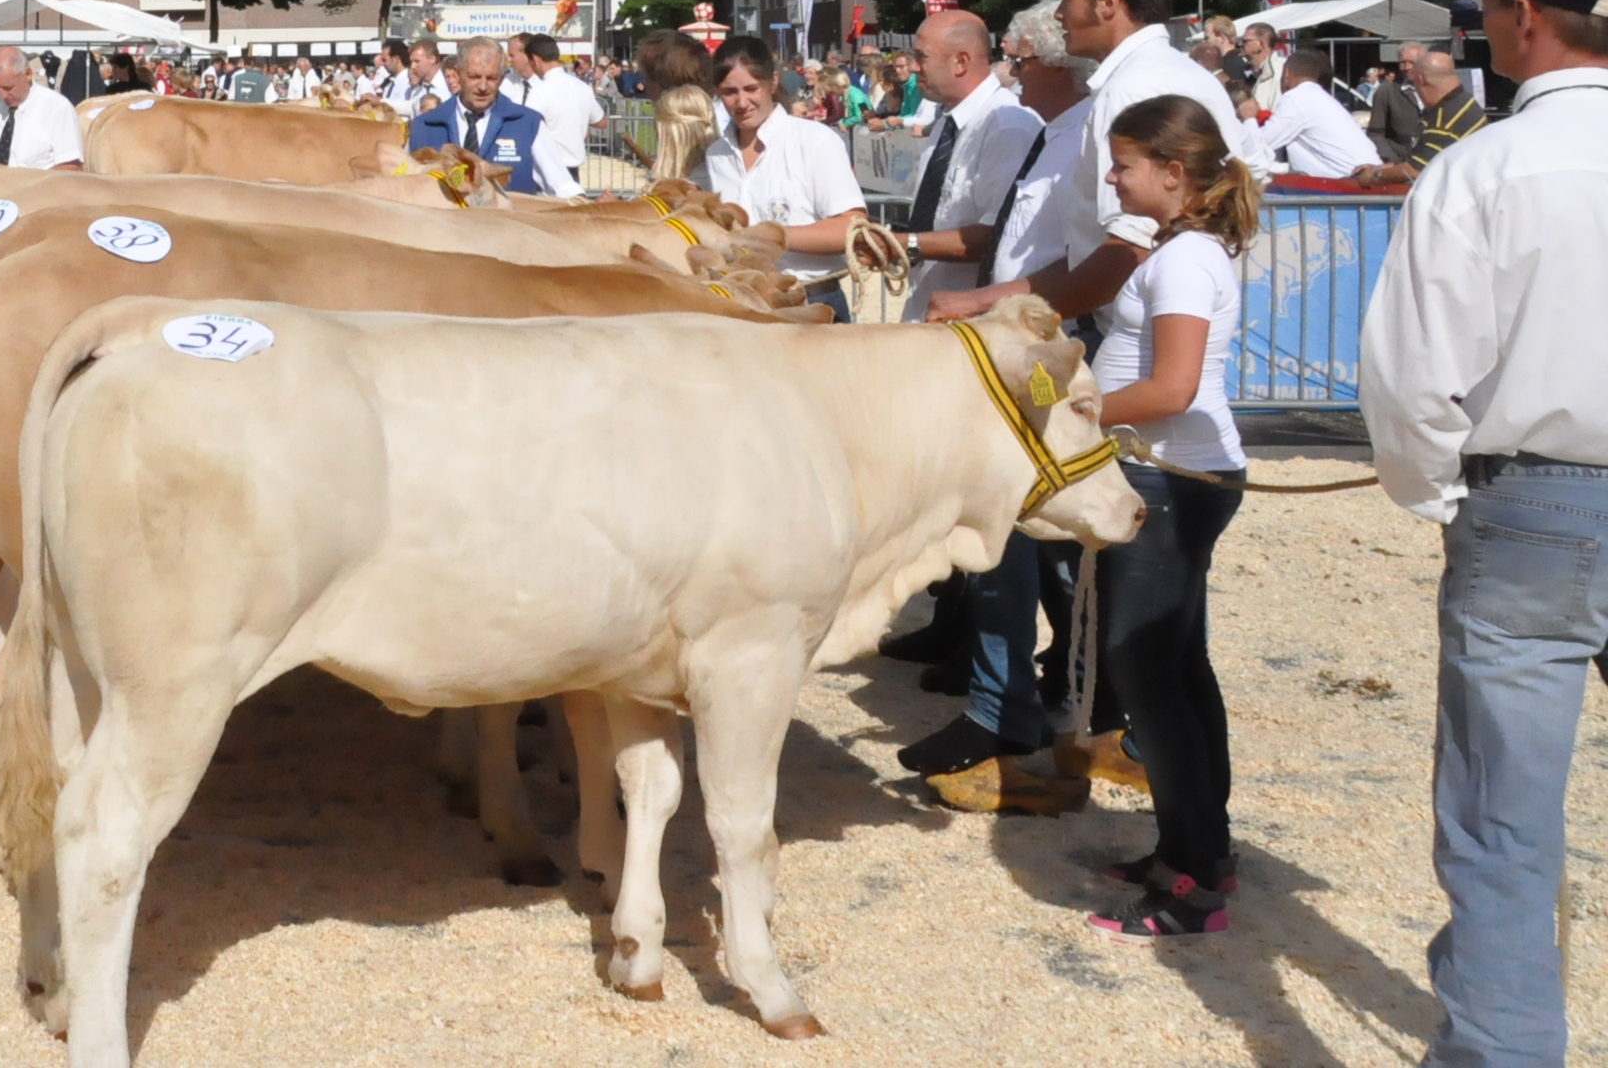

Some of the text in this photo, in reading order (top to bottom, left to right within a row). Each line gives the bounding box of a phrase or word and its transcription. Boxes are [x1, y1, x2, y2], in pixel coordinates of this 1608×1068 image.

[469, 12, 525, 22] Nijenhuis
[95, 222, 159, 249] 38
[177, 322, 248, 355] 34
